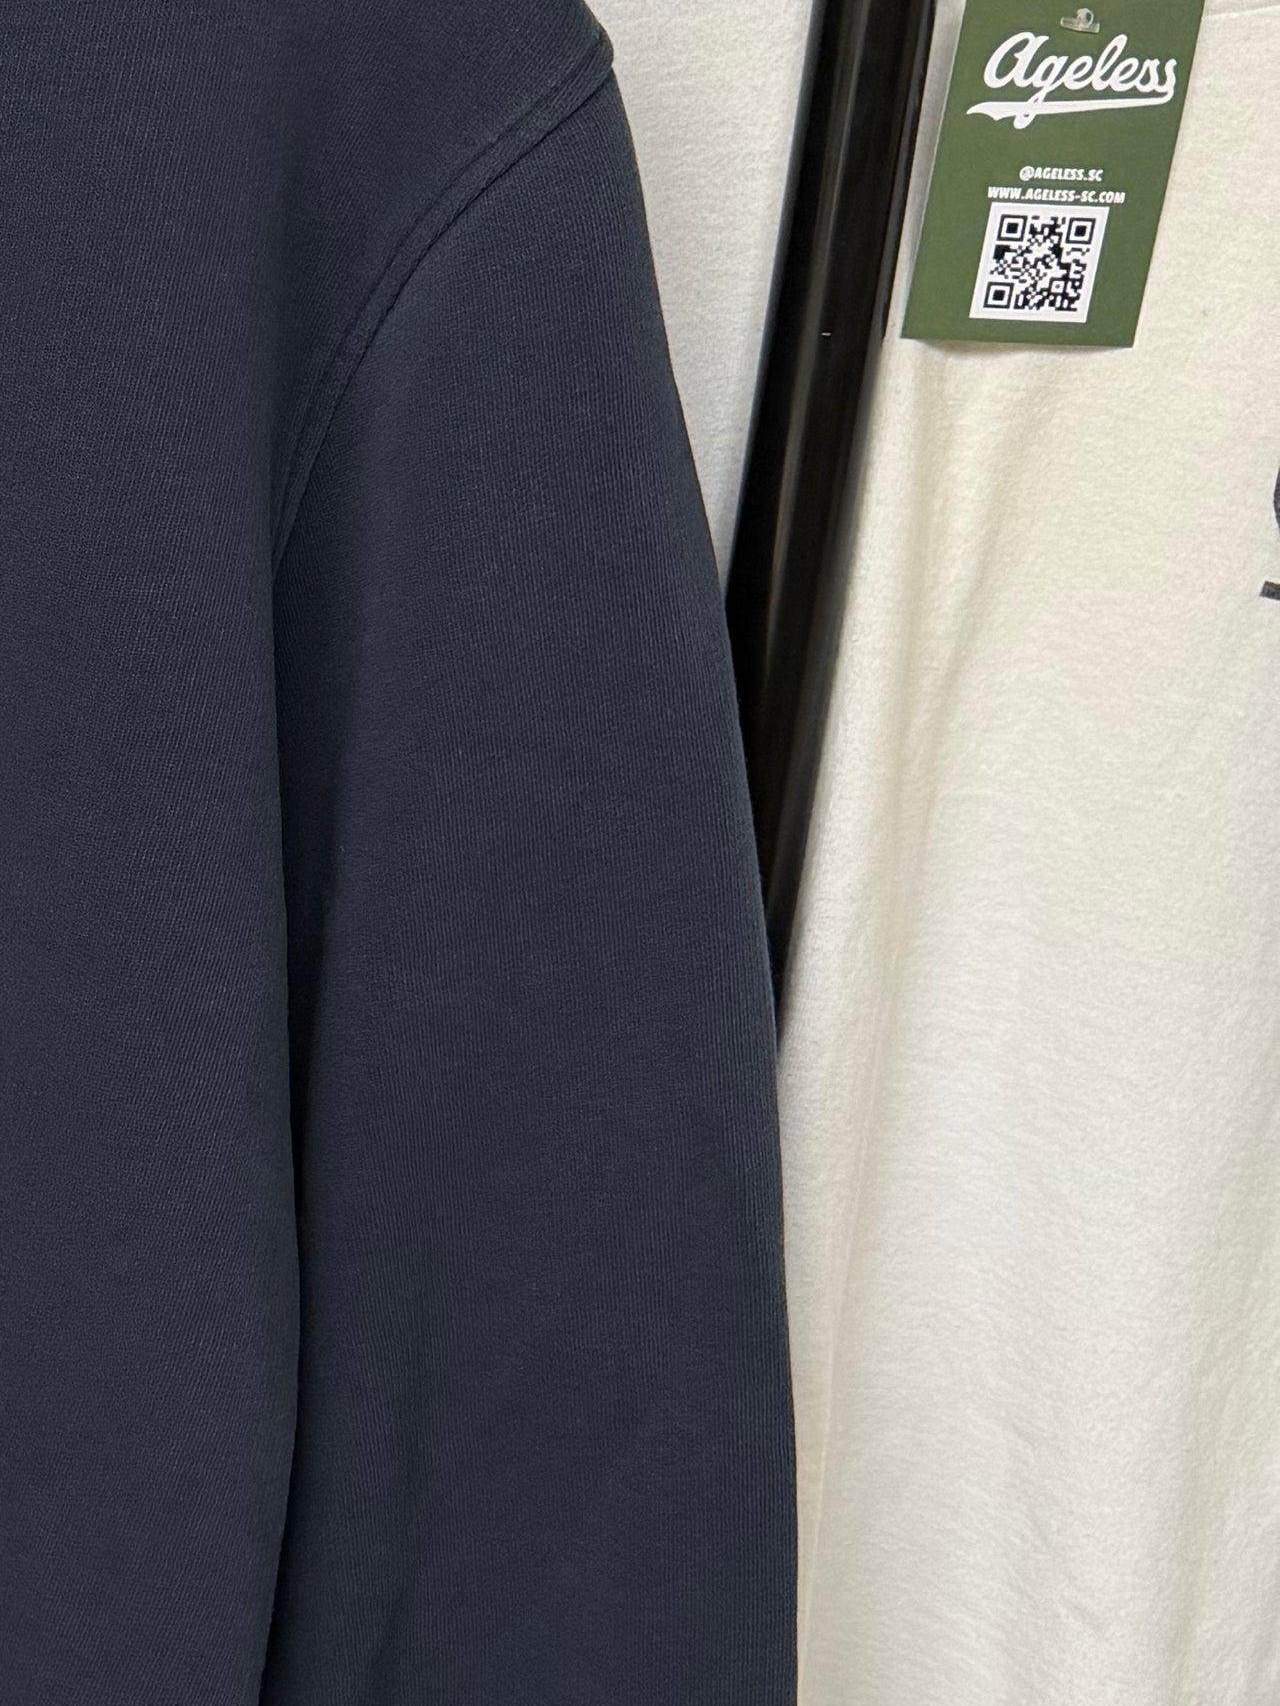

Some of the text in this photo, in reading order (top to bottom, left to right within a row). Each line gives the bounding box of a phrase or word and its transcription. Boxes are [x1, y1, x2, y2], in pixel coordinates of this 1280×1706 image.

[980, 31, 1178, 130] Ageless
[1019, 165, 1104, 182] @AGELESS.SC
[987, 186, 1126, 204] WWW.AGELESS-SC.COM
